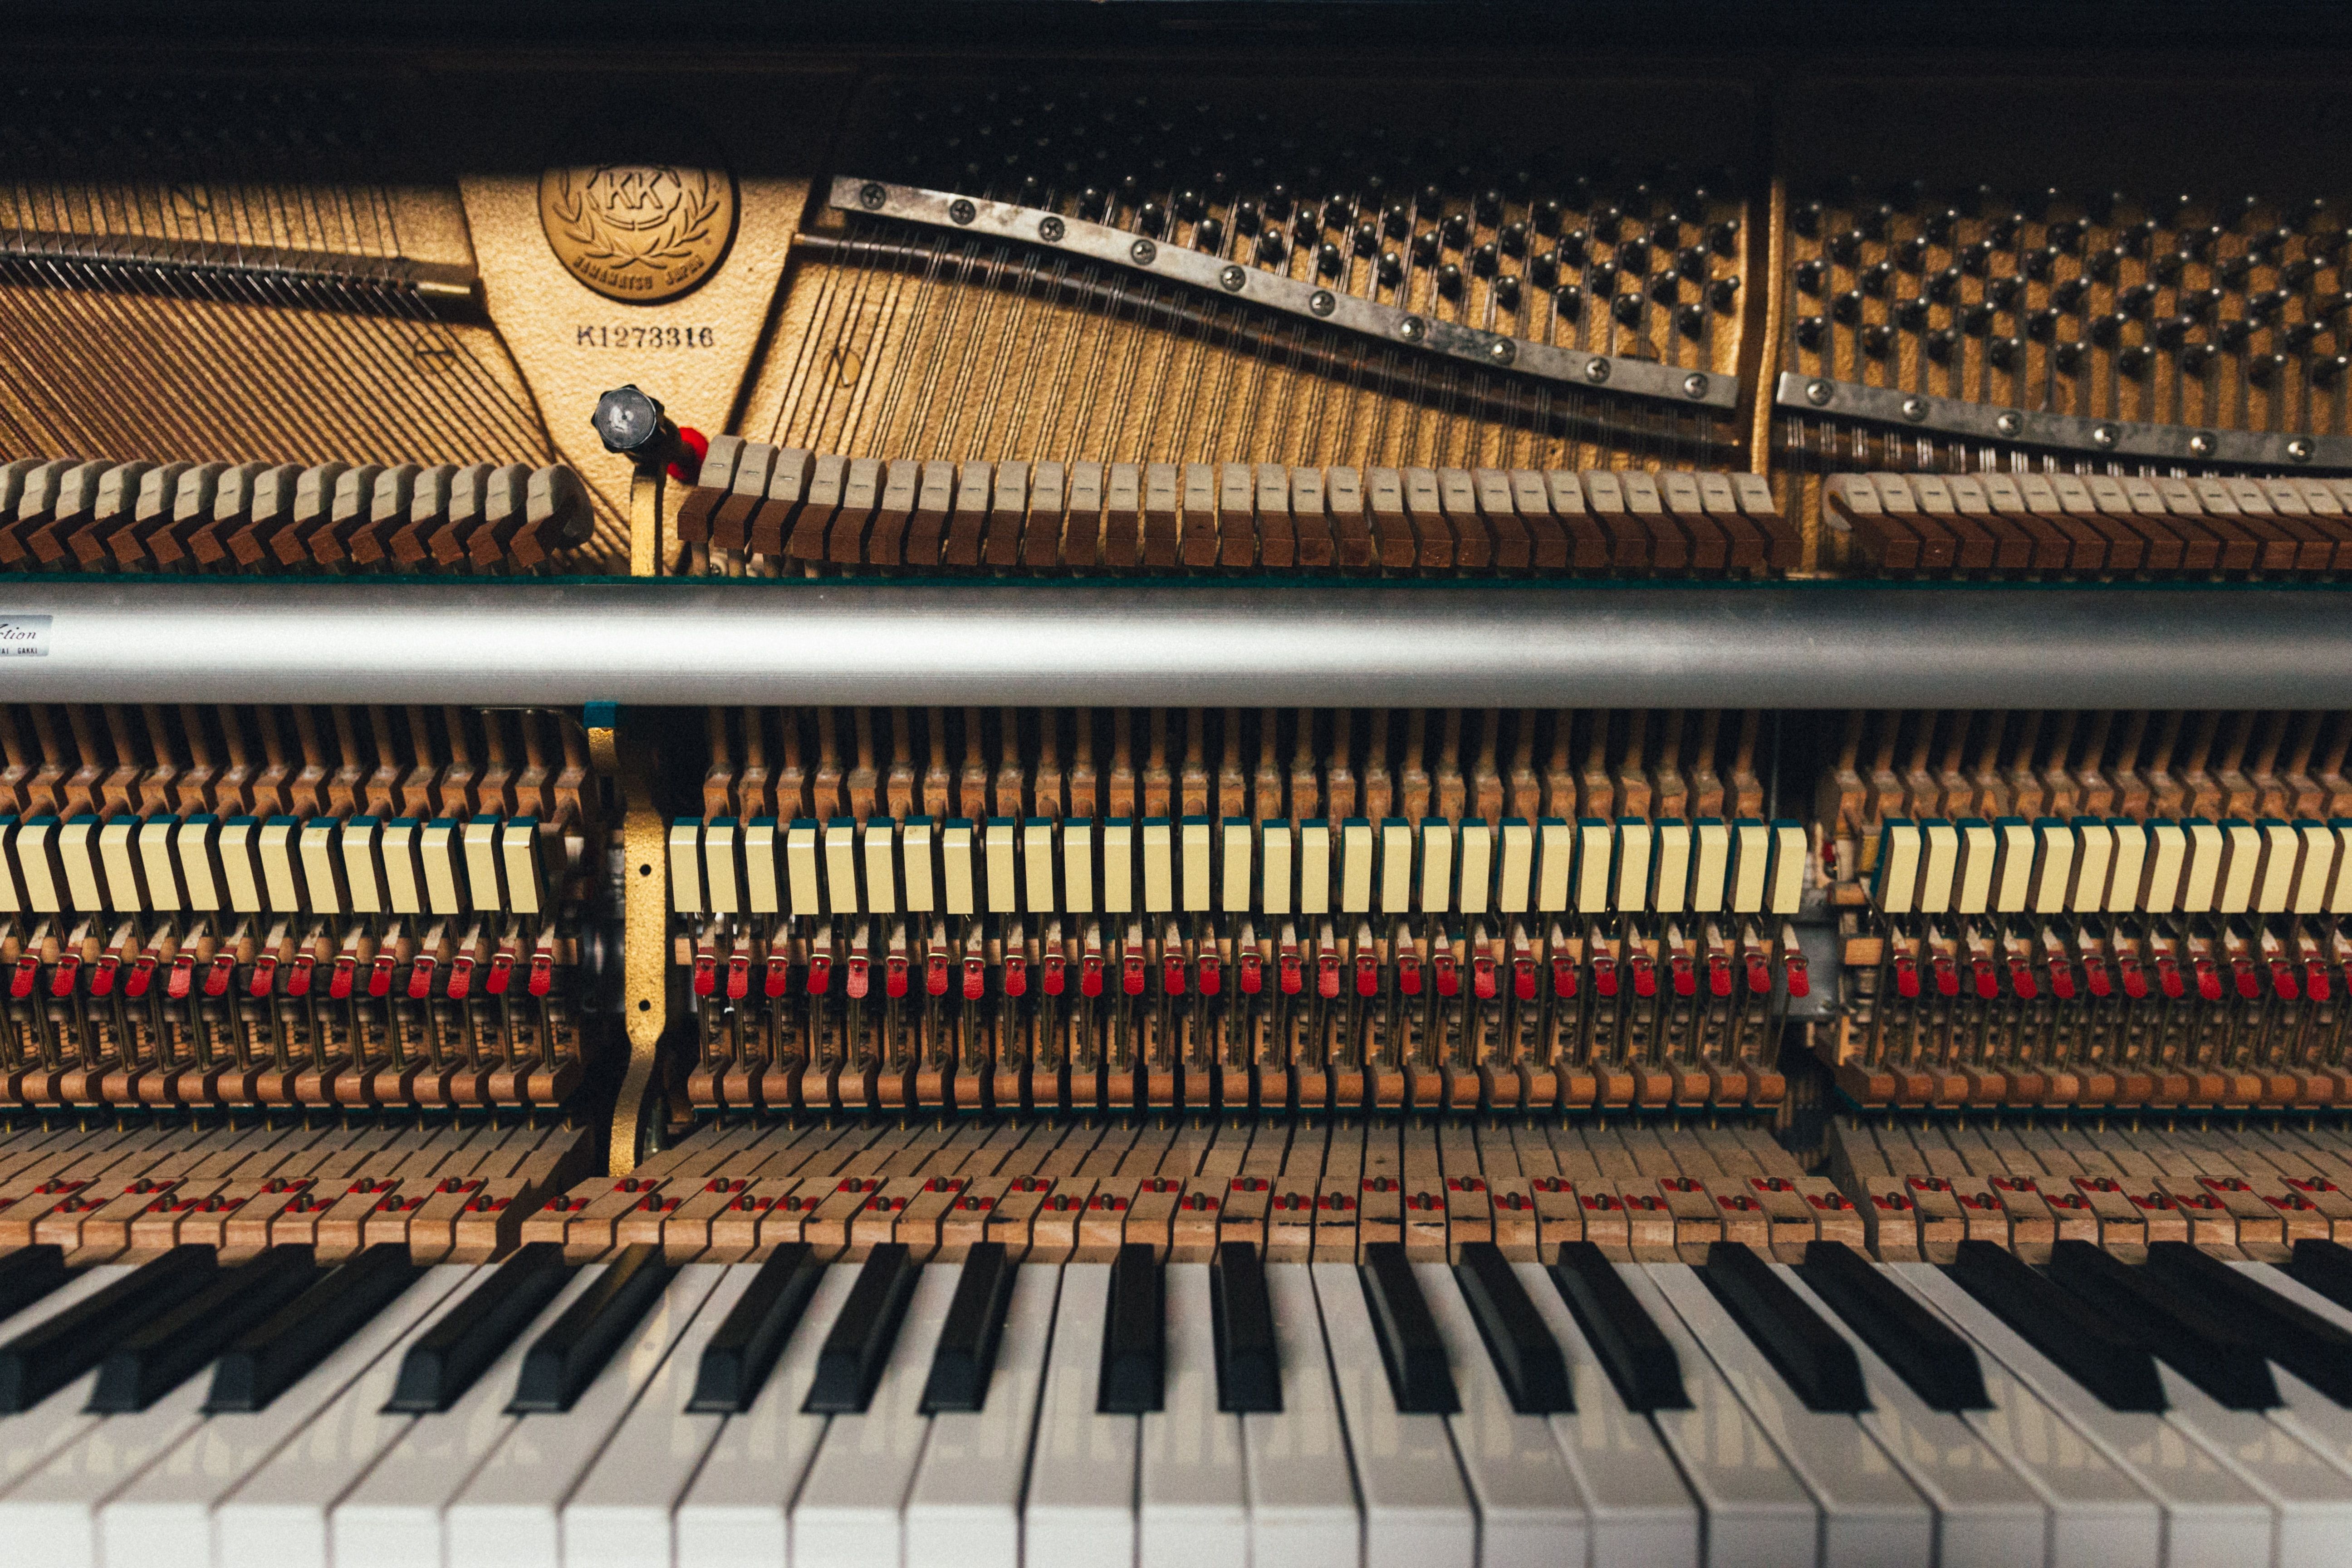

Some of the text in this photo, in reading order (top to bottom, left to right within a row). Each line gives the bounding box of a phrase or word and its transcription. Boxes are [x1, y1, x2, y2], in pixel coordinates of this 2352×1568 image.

[665, 254, 705, 285] JAPAN
[577, 325, 714, 348] K1273316
[0, 627, 36, 640] tion
